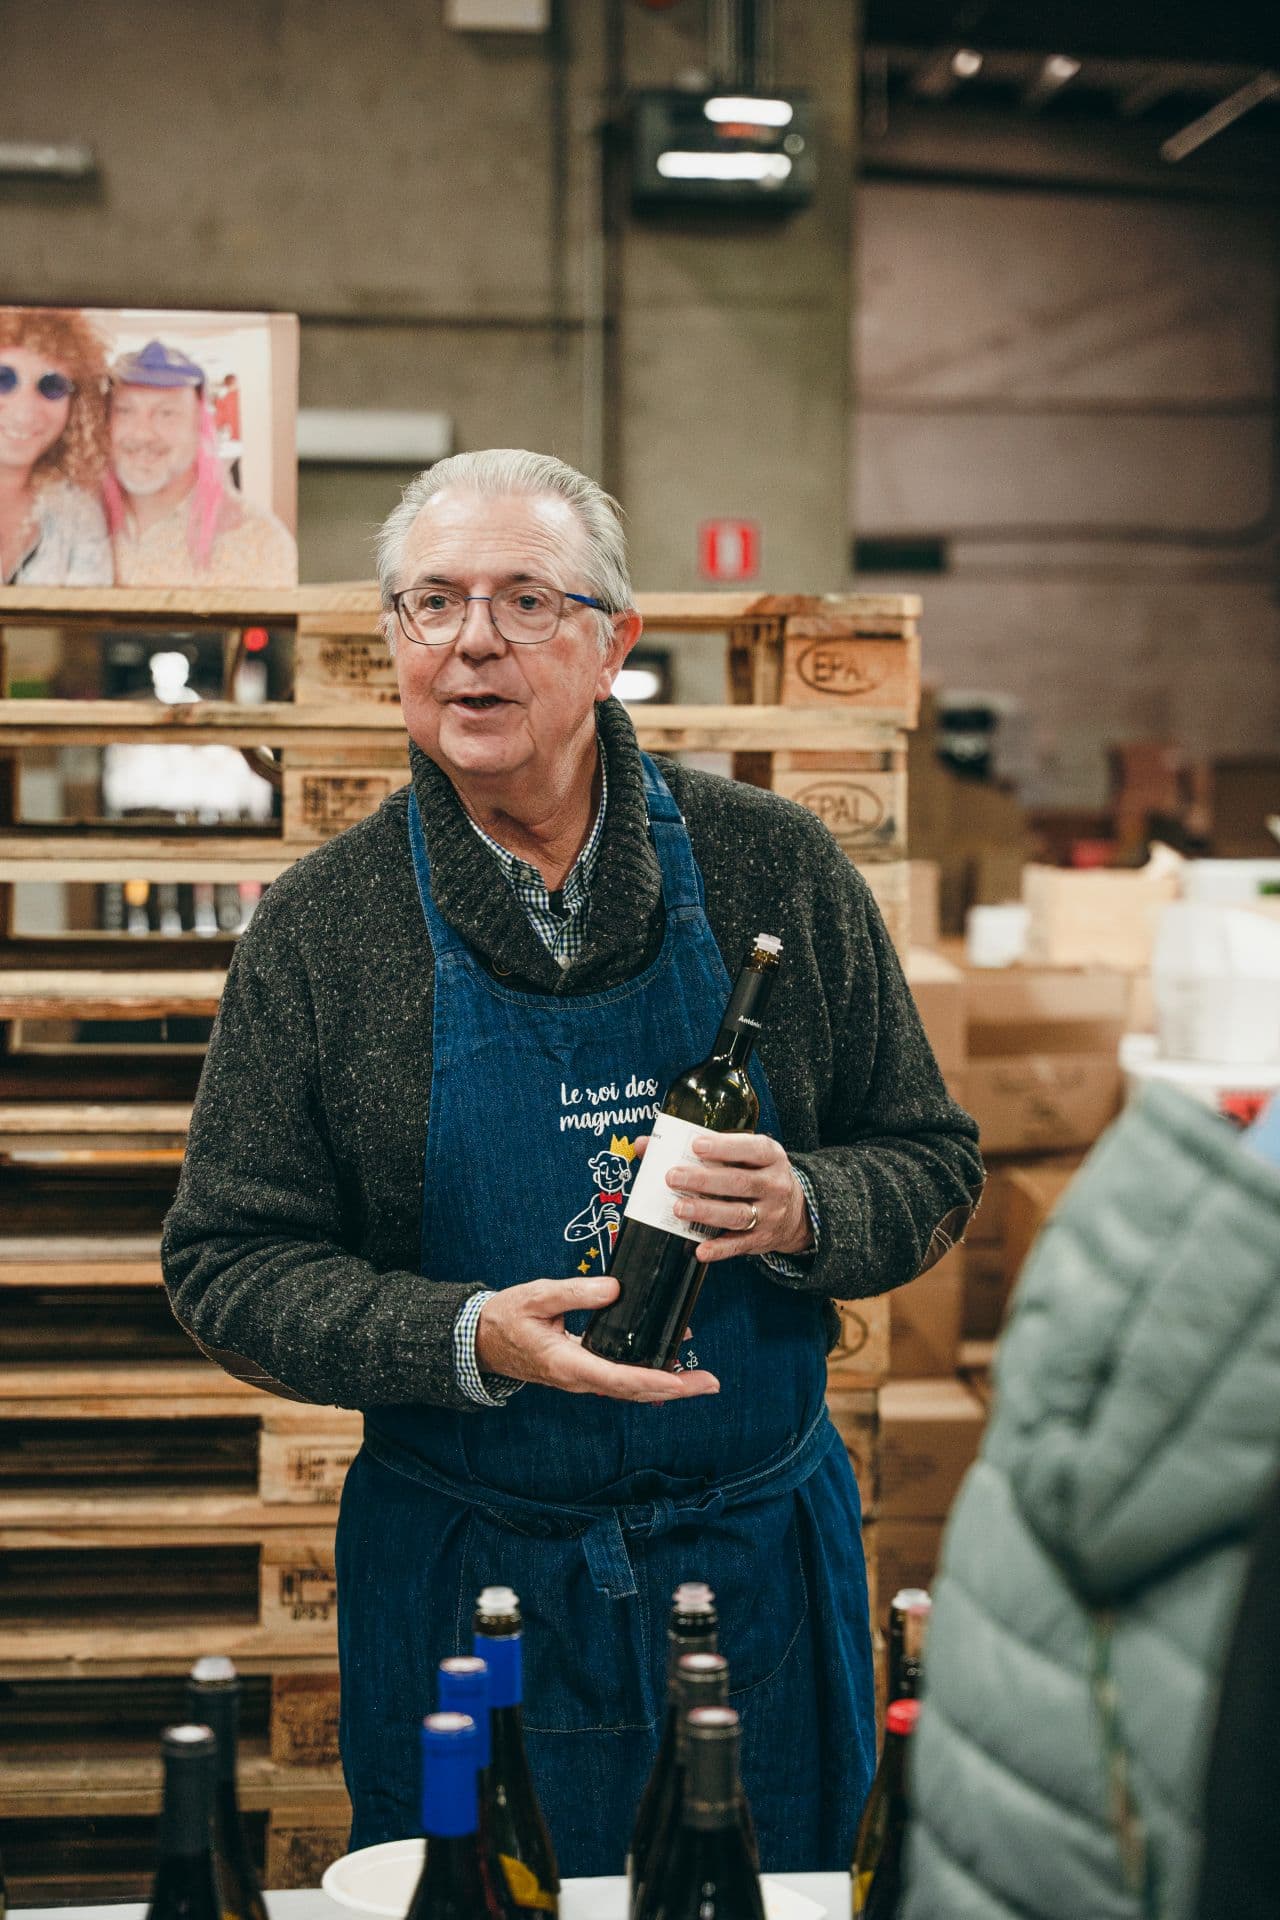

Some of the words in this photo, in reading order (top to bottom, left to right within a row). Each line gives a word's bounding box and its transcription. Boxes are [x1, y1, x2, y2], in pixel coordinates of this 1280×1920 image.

[813, 651, 866, 682] EPA
[561, 1082, 583, 1106] Le
[585, 1082, 620, 1106] roi
[625, 1074, 659, 1099] des
[560, 1102, 661, 1136] magnums
